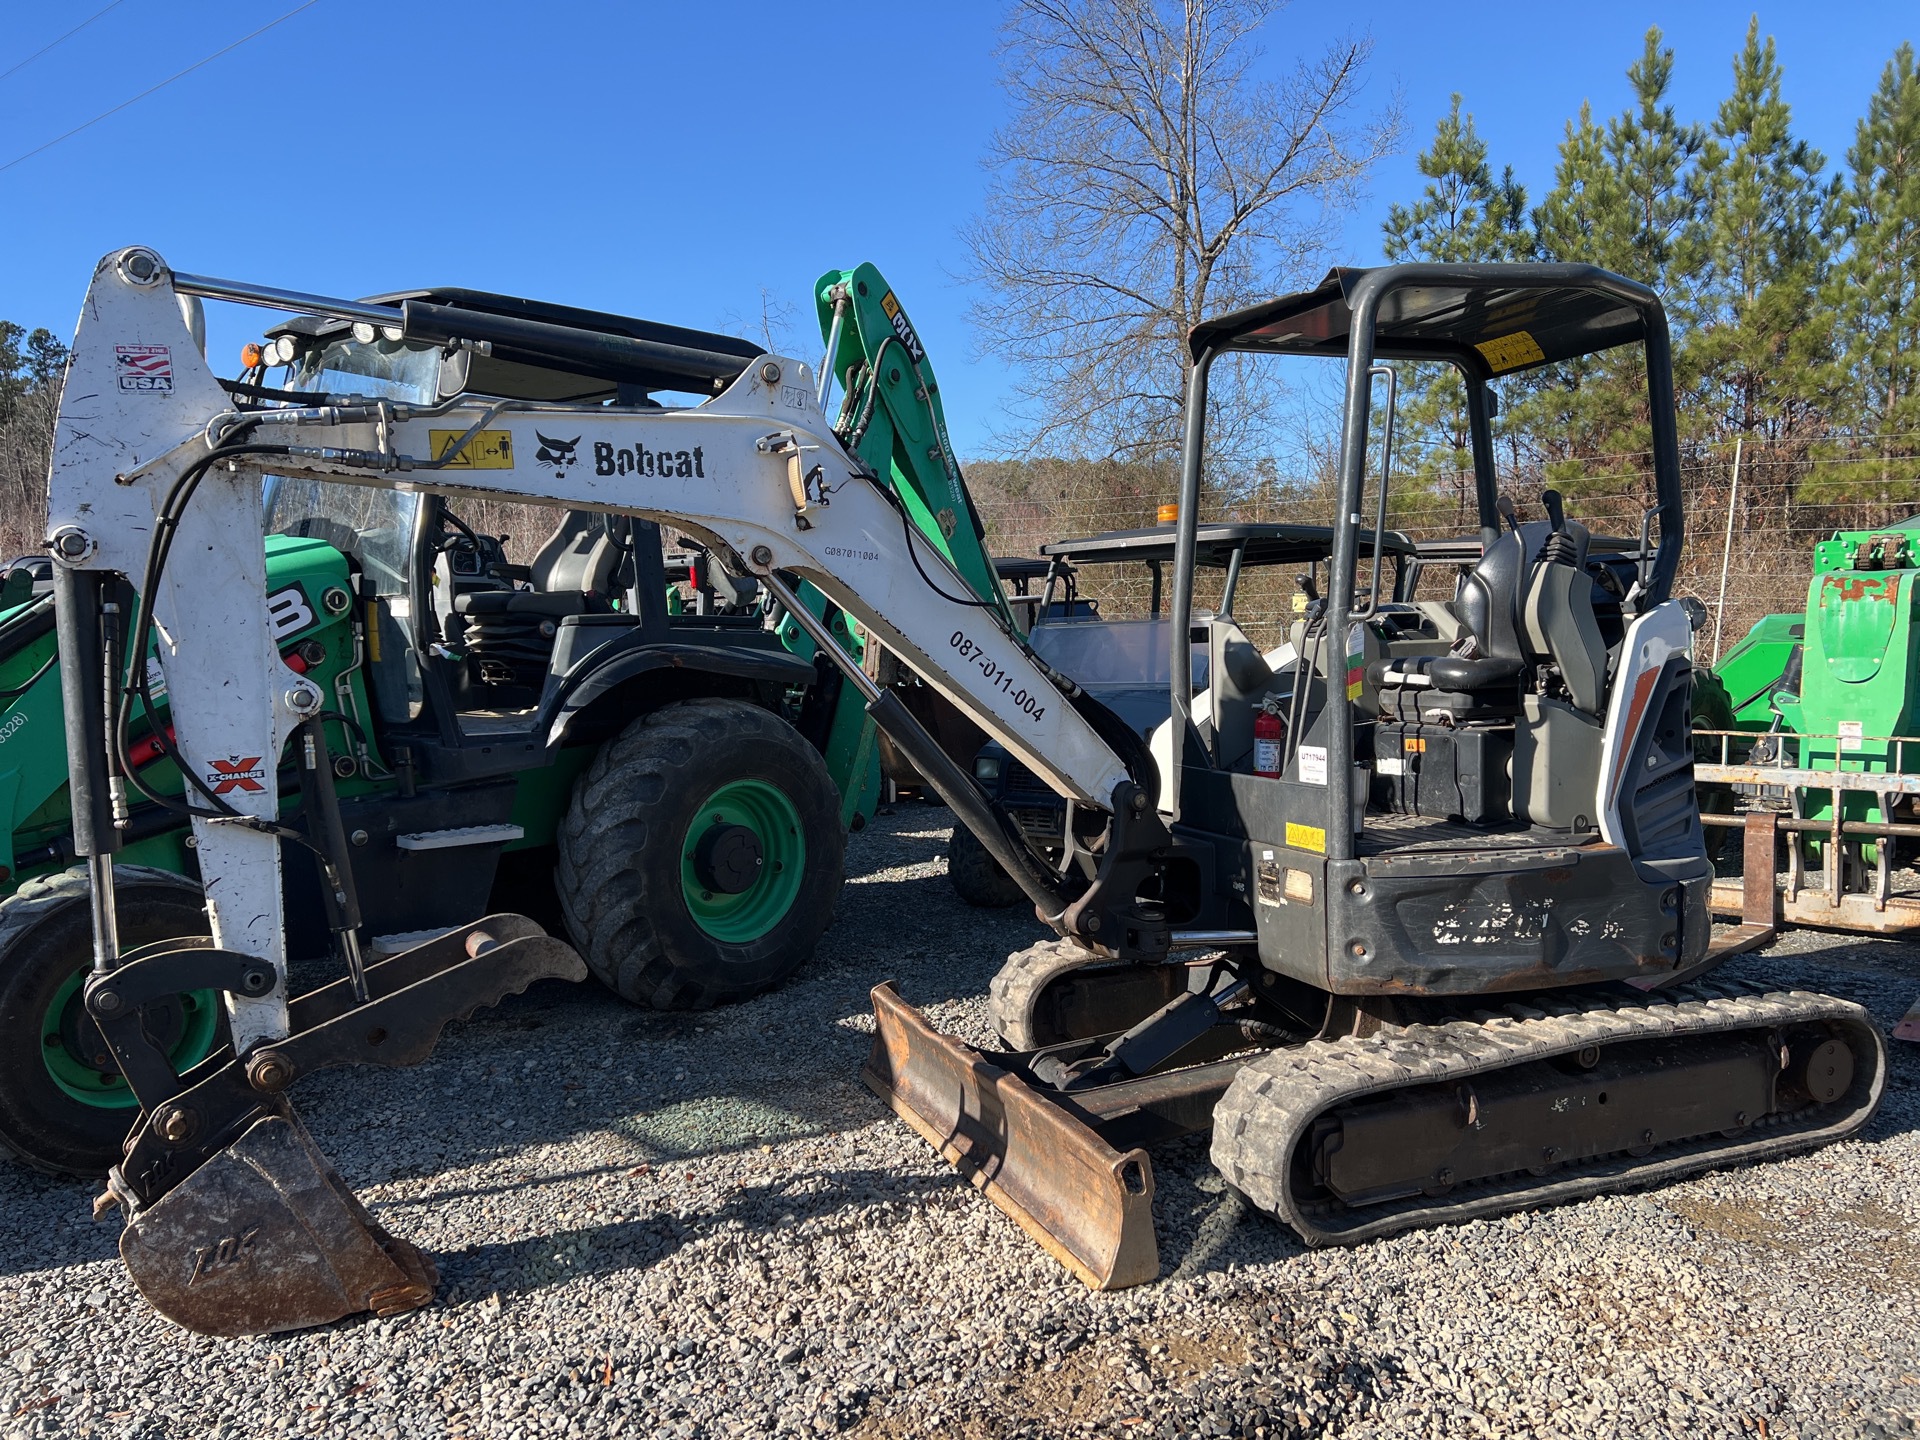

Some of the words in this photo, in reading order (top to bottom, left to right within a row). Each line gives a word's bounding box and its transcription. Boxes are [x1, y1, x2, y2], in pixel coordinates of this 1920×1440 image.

[892, 312, 923, 360] 3CX
[121, 378, 170, 389] USA
[594, 442, 704, 478] Bobcat
[825, 546, 879, 560] G087011004
[950, 631, 1045, 722] 087-011-004
[209, 771, 263, 781] X-CHANGE
